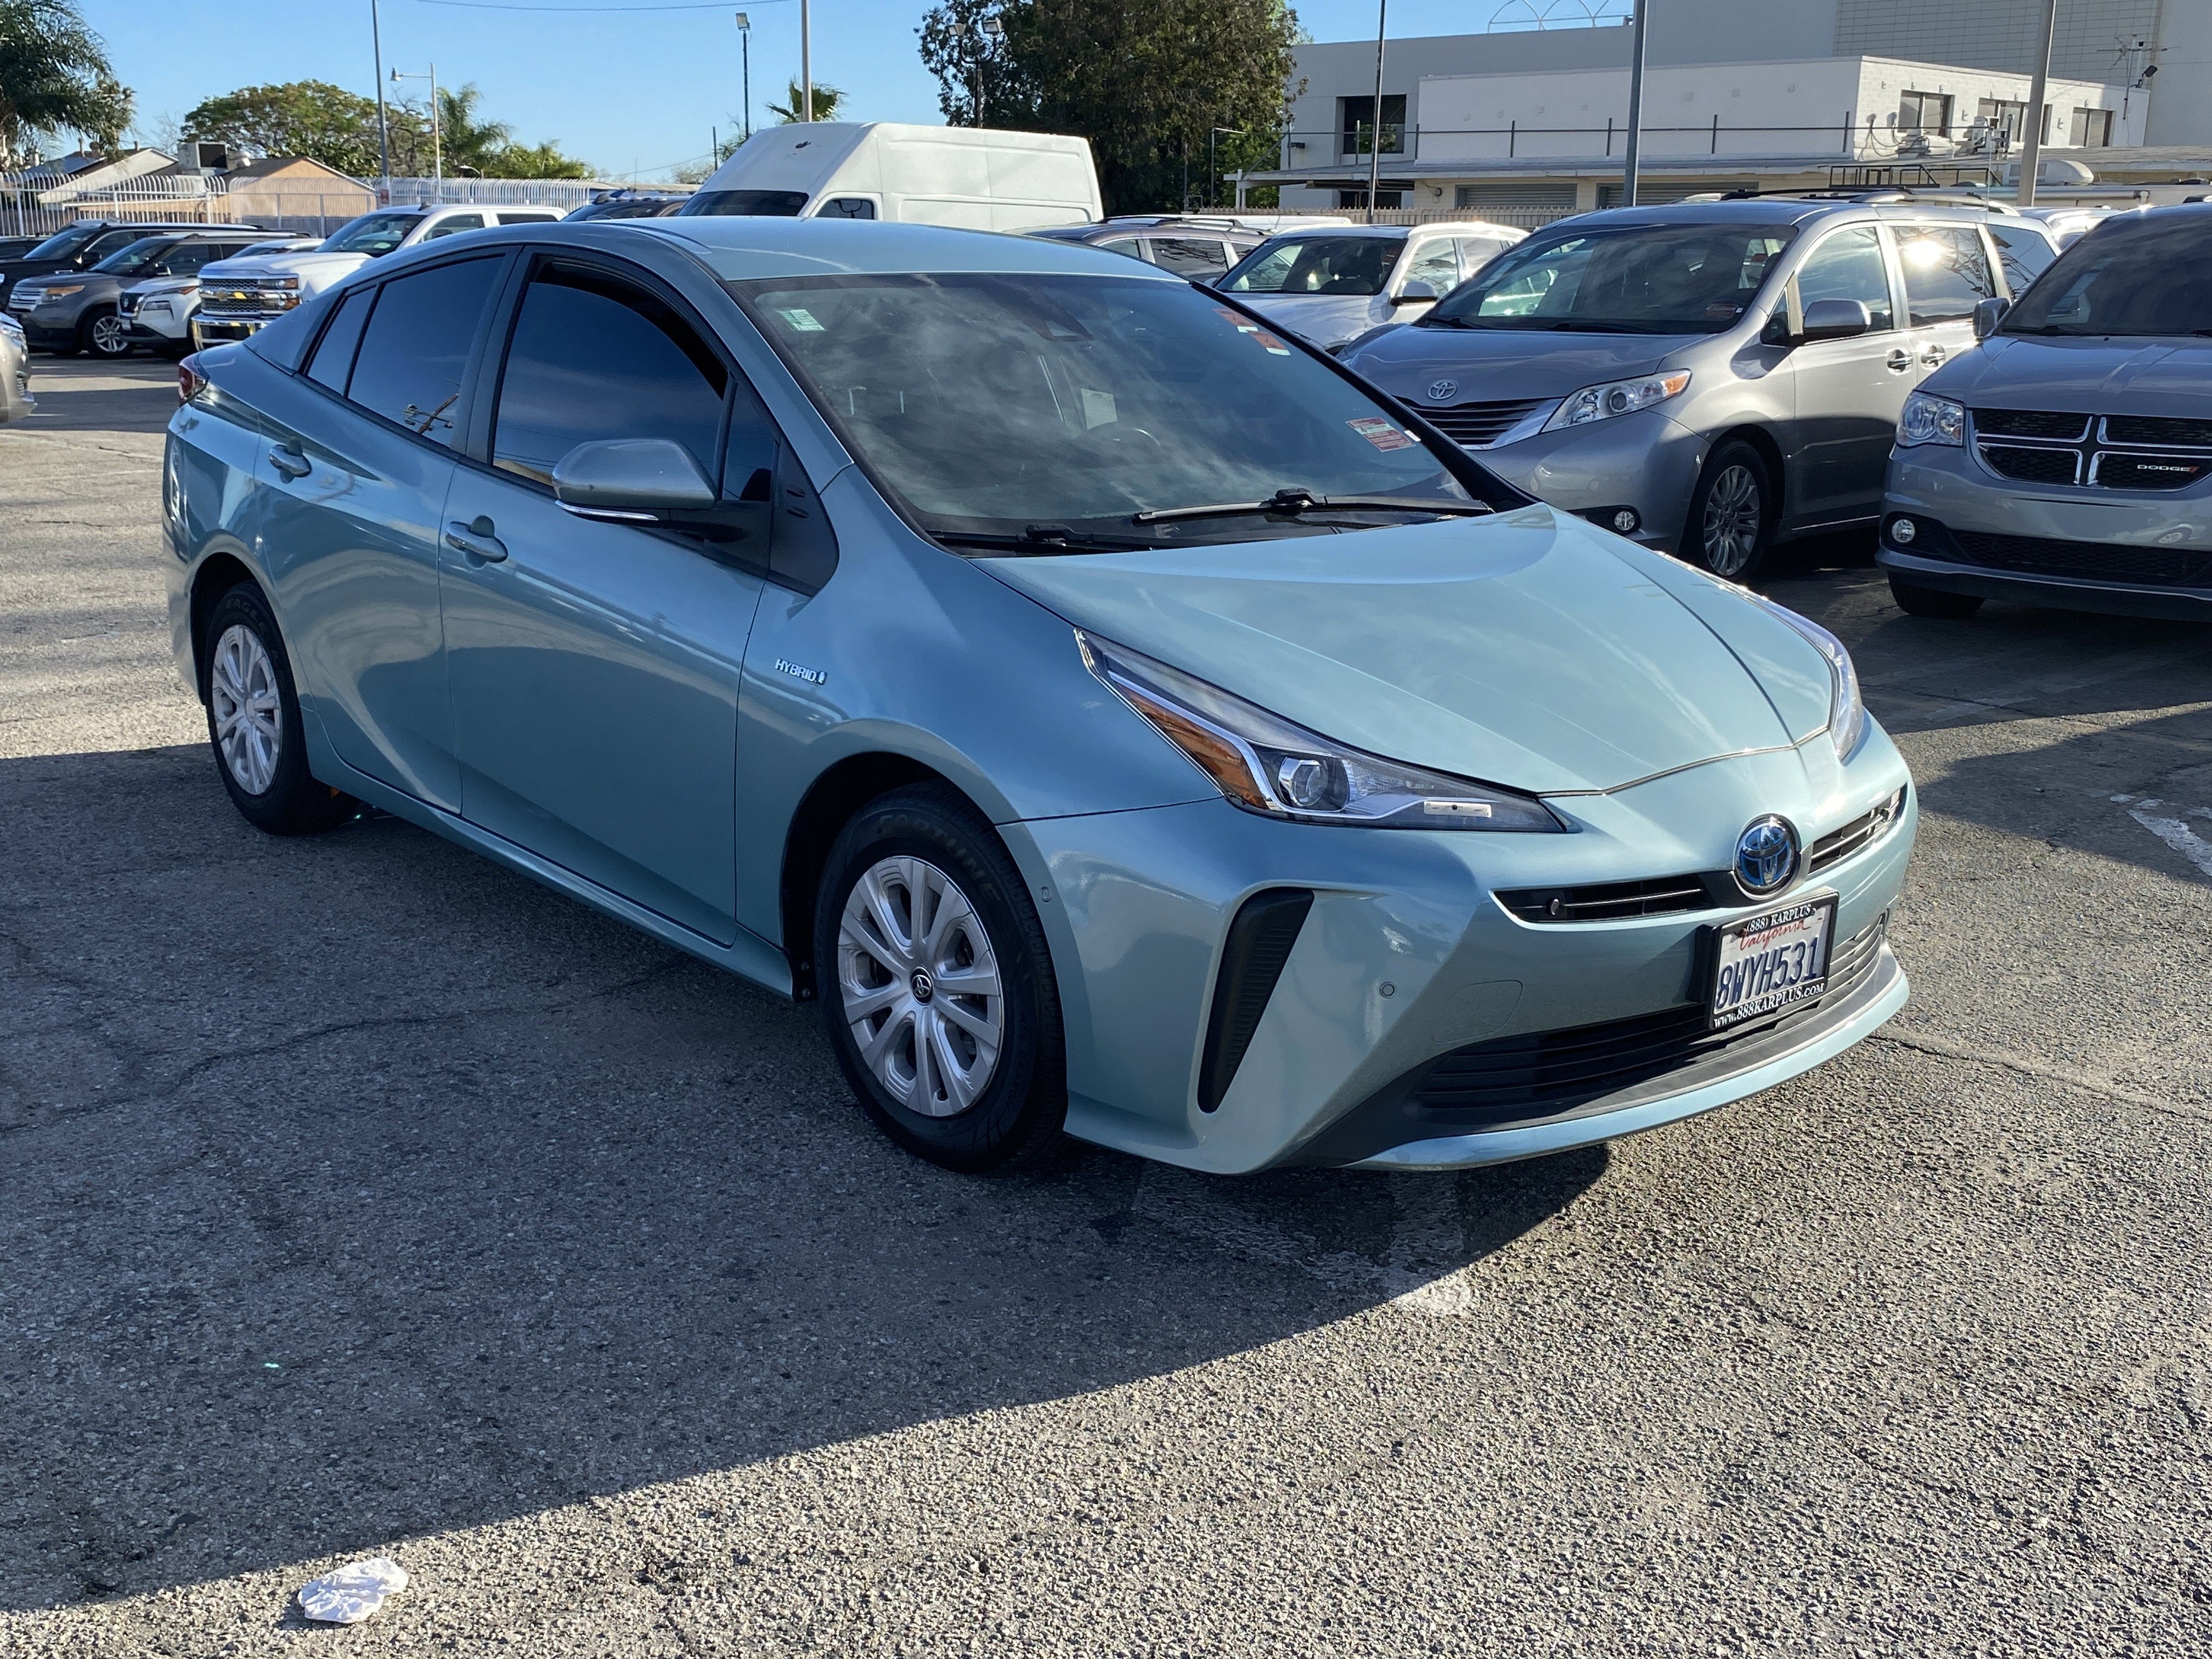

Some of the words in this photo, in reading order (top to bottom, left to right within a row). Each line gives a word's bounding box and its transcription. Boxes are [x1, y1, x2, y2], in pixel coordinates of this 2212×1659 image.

[774, 658, 817, 682] HYBRID
[1746, 917, 1768, 933] (888)
[1770, 904, 1812, 927] KARPLUS
[1740, 918, 1811, 951] California
[1716, 934, 1819, 1009] 8WYH531
